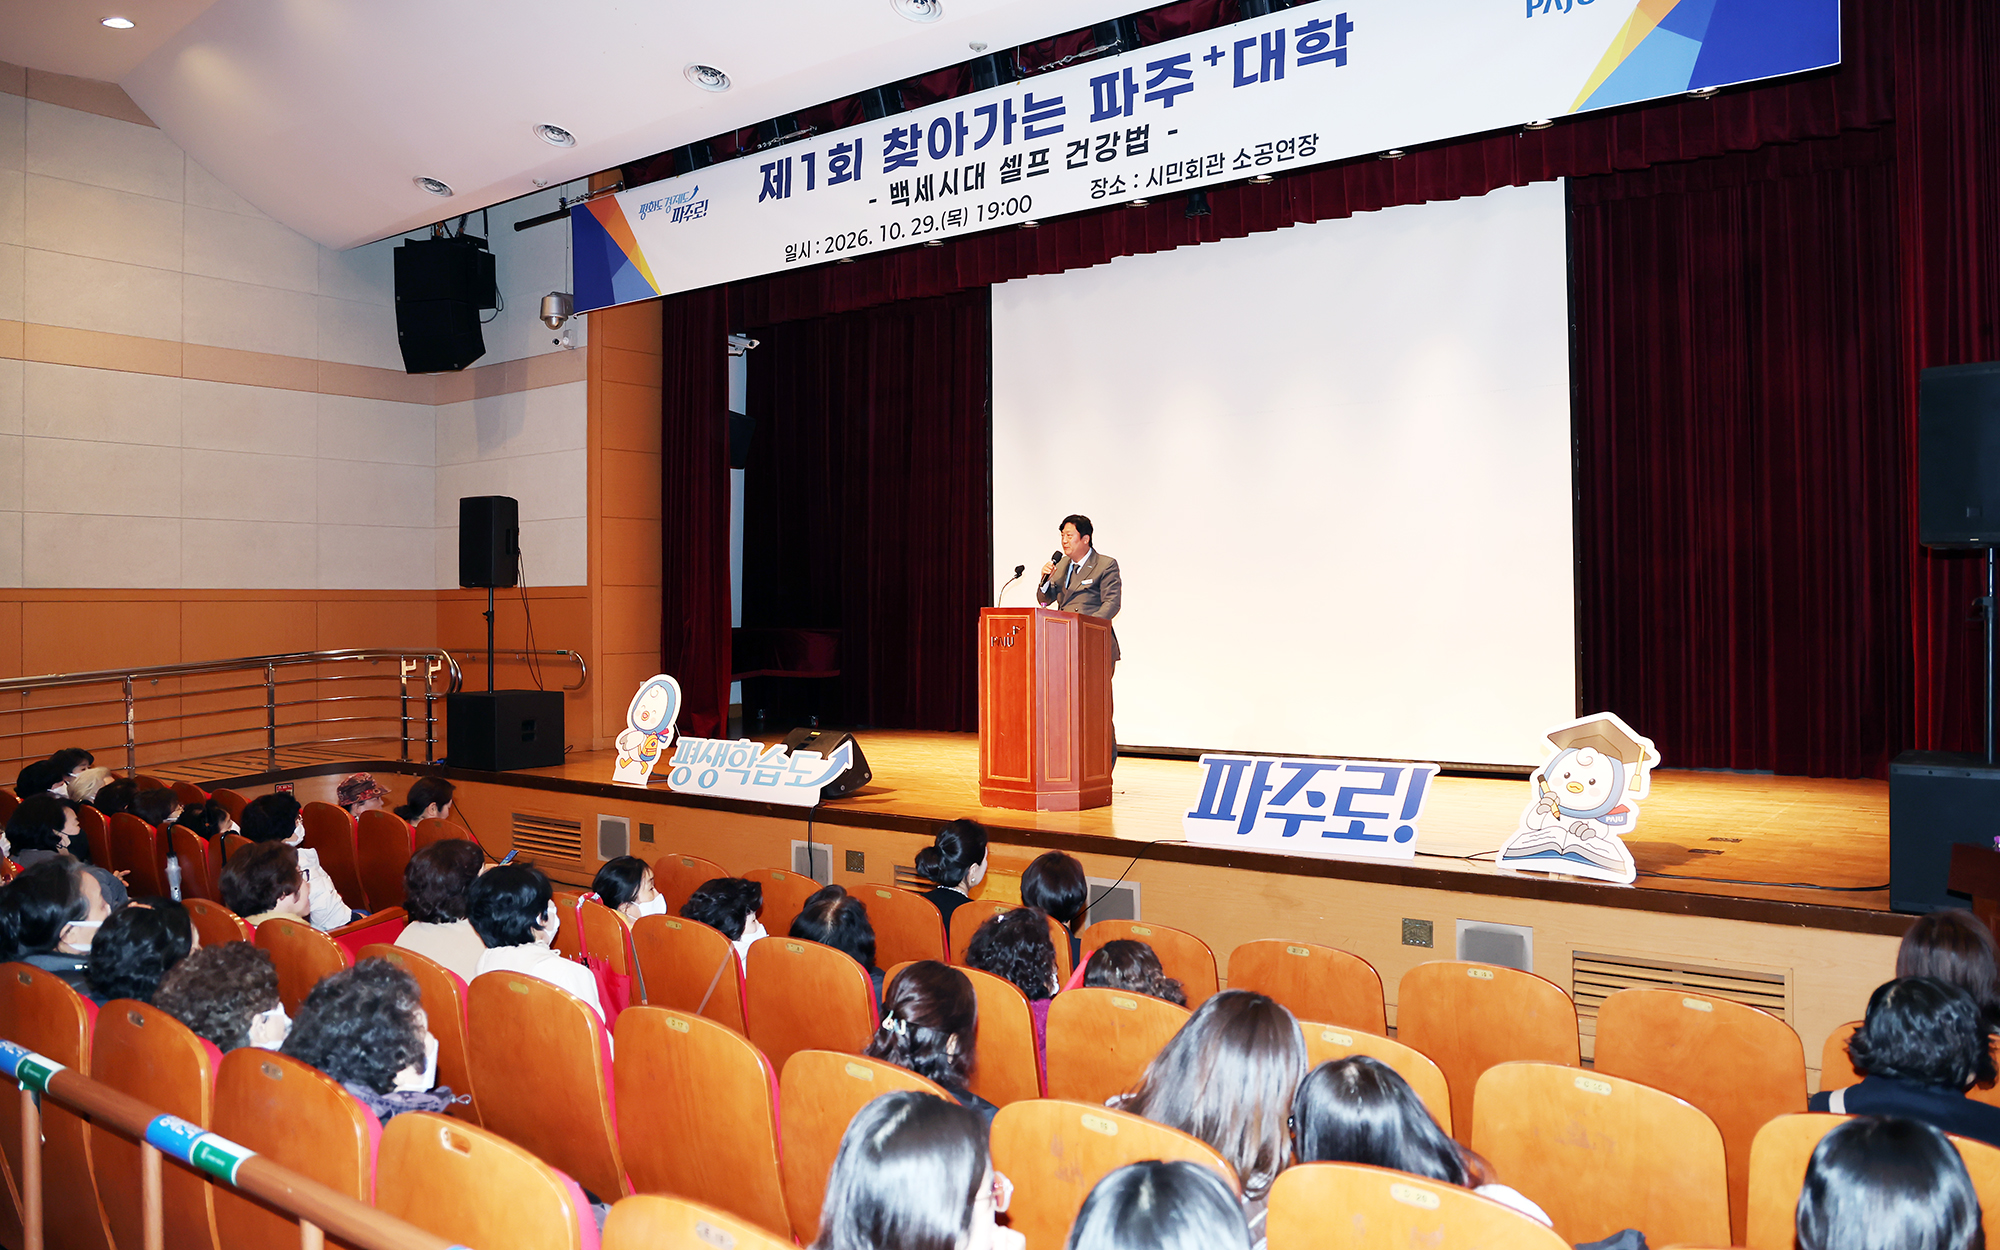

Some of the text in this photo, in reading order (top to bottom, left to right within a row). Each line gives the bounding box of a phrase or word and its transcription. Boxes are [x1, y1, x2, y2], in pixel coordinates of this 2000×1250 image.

[759, 138, 862, 203] 제1회
[883, 92, 1066, 173] 찾아가는
[890, 162, 985, 205] 백세시대
[1000, 148, 1049, 184] 셀프
[1066, 124, 1149, 169] 건강법
[1146, 153, 1225, 187] 시민회관
[1233, 133, 1319, 170] 소공연장
[670, 199, 709, 223] 파주로!
[881, 223, 905, 241] 10.
[912, 207, 967, 236] 29.(목)
[978, 195, 1031, 222] 19:00
[672, 740, 818, 788] 평생학습도
[1187, 758, 1434, 843] 파주로!
